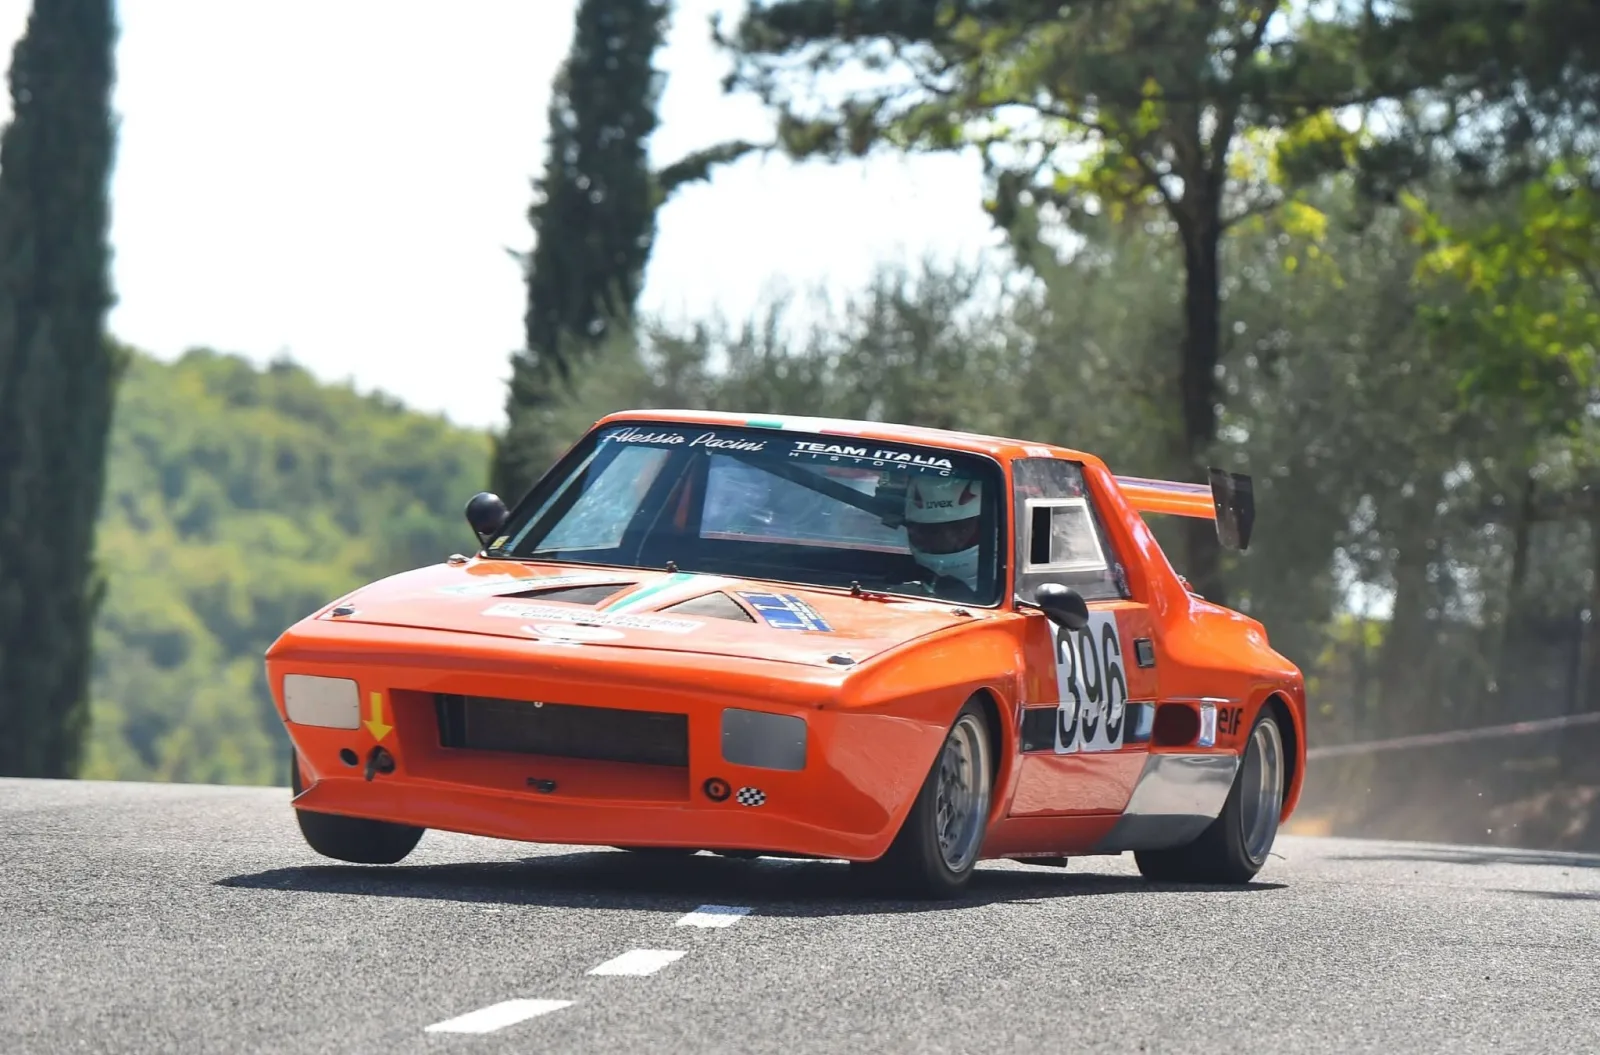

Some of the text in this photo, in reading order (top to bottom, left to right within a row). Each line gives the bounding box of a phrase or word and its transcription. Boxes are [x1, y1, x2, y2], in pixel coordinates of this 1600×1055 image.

[602, 427, 767, 451] Alessio Pacini
[789, 452, 950, 477] HISTORIC
[795, 441, 952, 468] TEAM ITALIA
[926, 500, 953, 510] uvex
[1057, 620, 1128, 748] 396
[1217, 707, 1243, 735] elf
